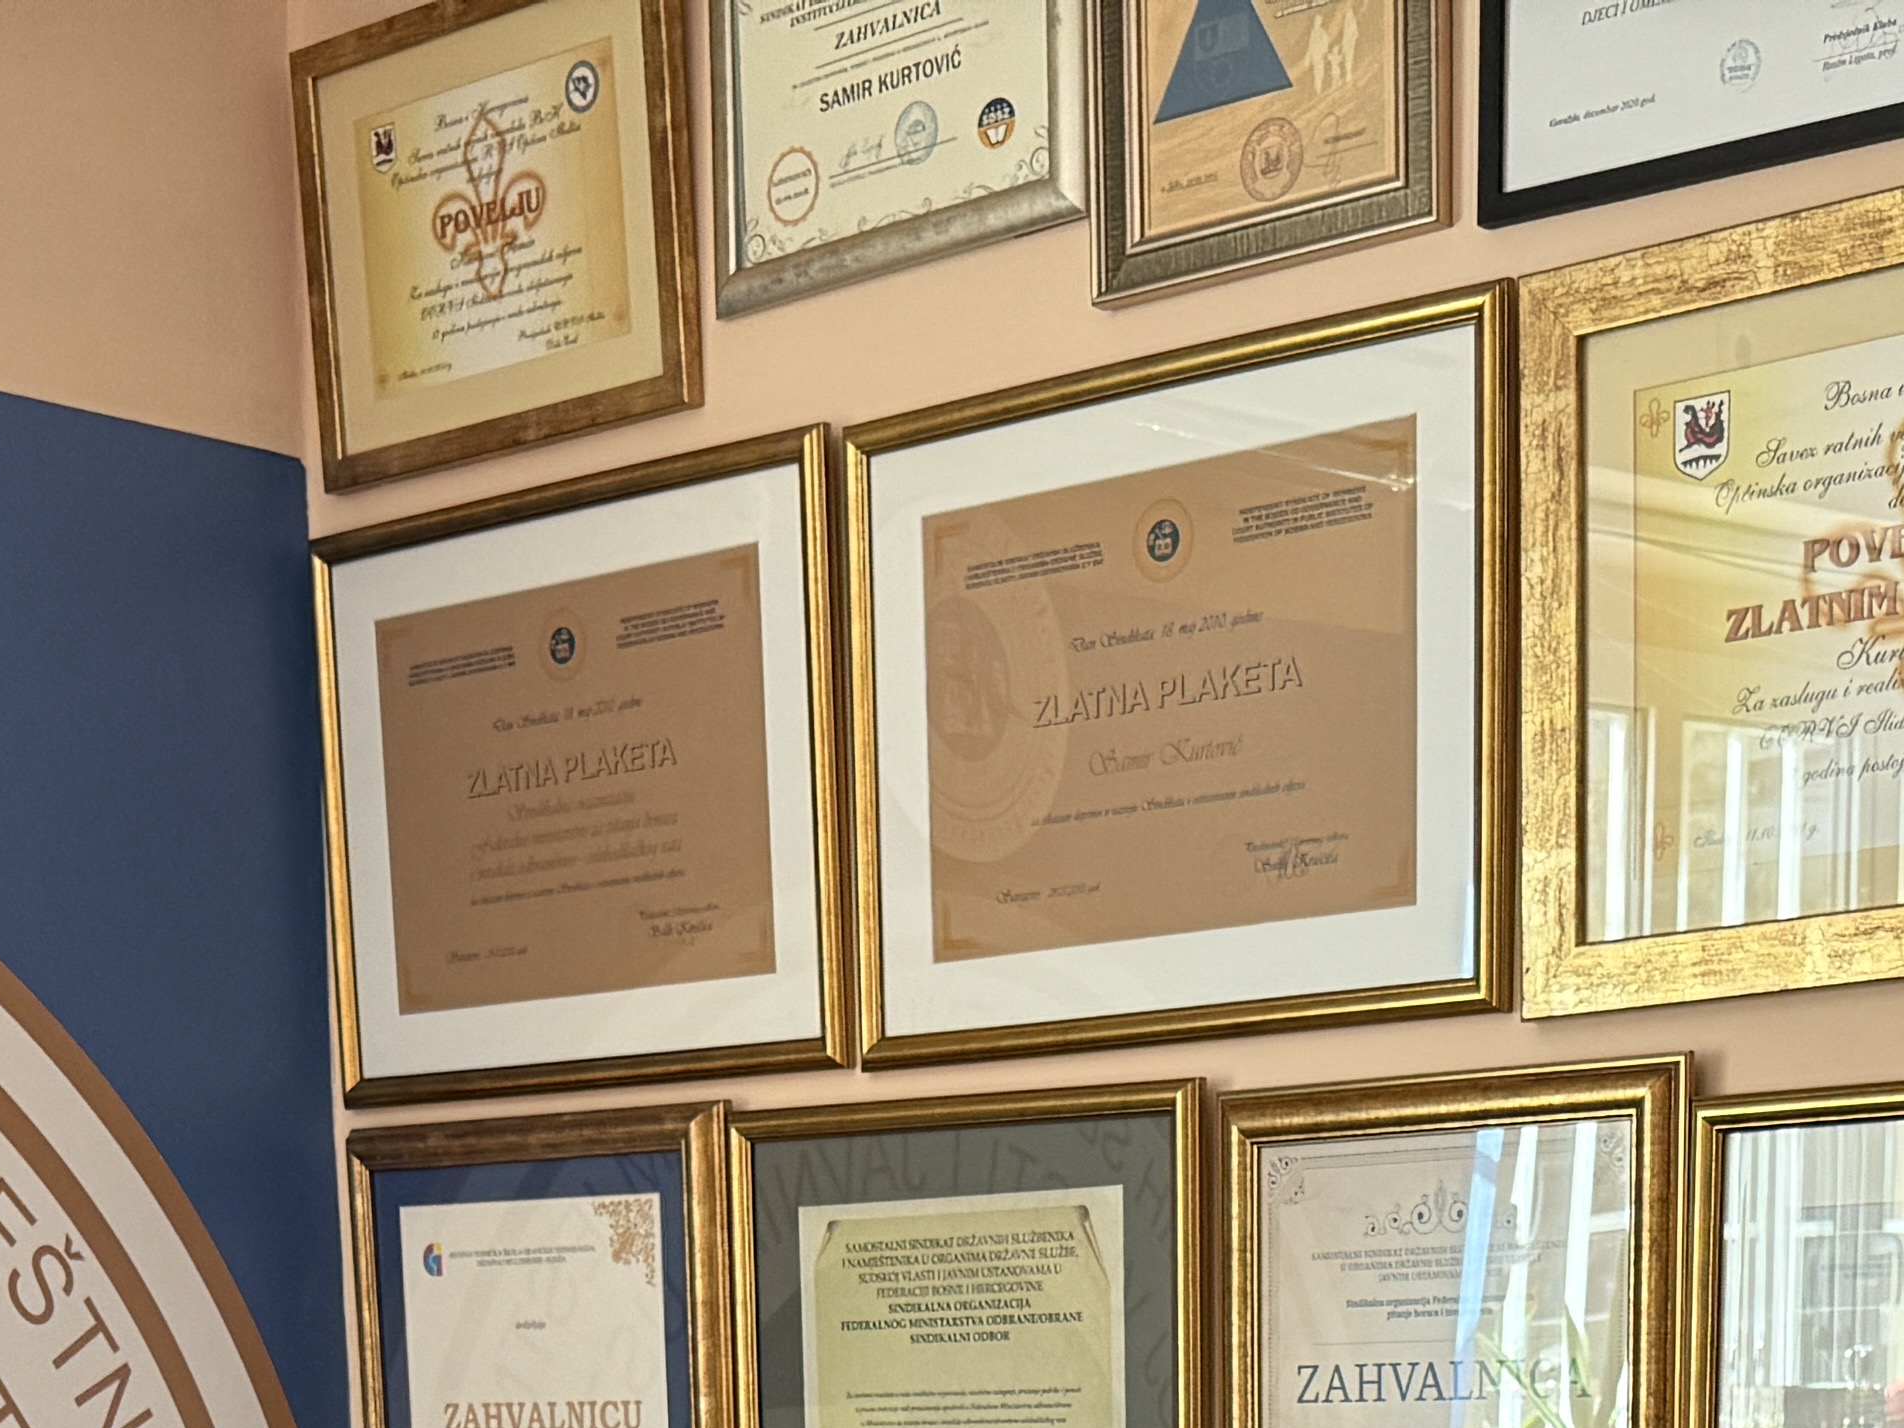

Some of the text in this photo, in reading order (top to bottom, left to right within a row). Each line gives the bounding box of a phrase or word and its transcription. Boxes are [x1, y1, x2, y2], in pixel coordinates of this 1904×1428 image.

[834, 1, 943, 50] ZAHVALNICA
[819, 45, 963, 113] SAMIR KURTOVIĆ
[437, 186, 543, 239] POVELJU
[1824, 379, 1892, 411] Bosna
[1824, 422, 1883, 456] ratnih
[1724, 577, 1900, 643] ZLATNIM
[1033, 656, 1304, 729] ZLATNA PLAKETA
[467, 737, 678, 800] ZLATNA PLAKETA
[1296, 1357, 1592, 1404] ZAHVALNCA
